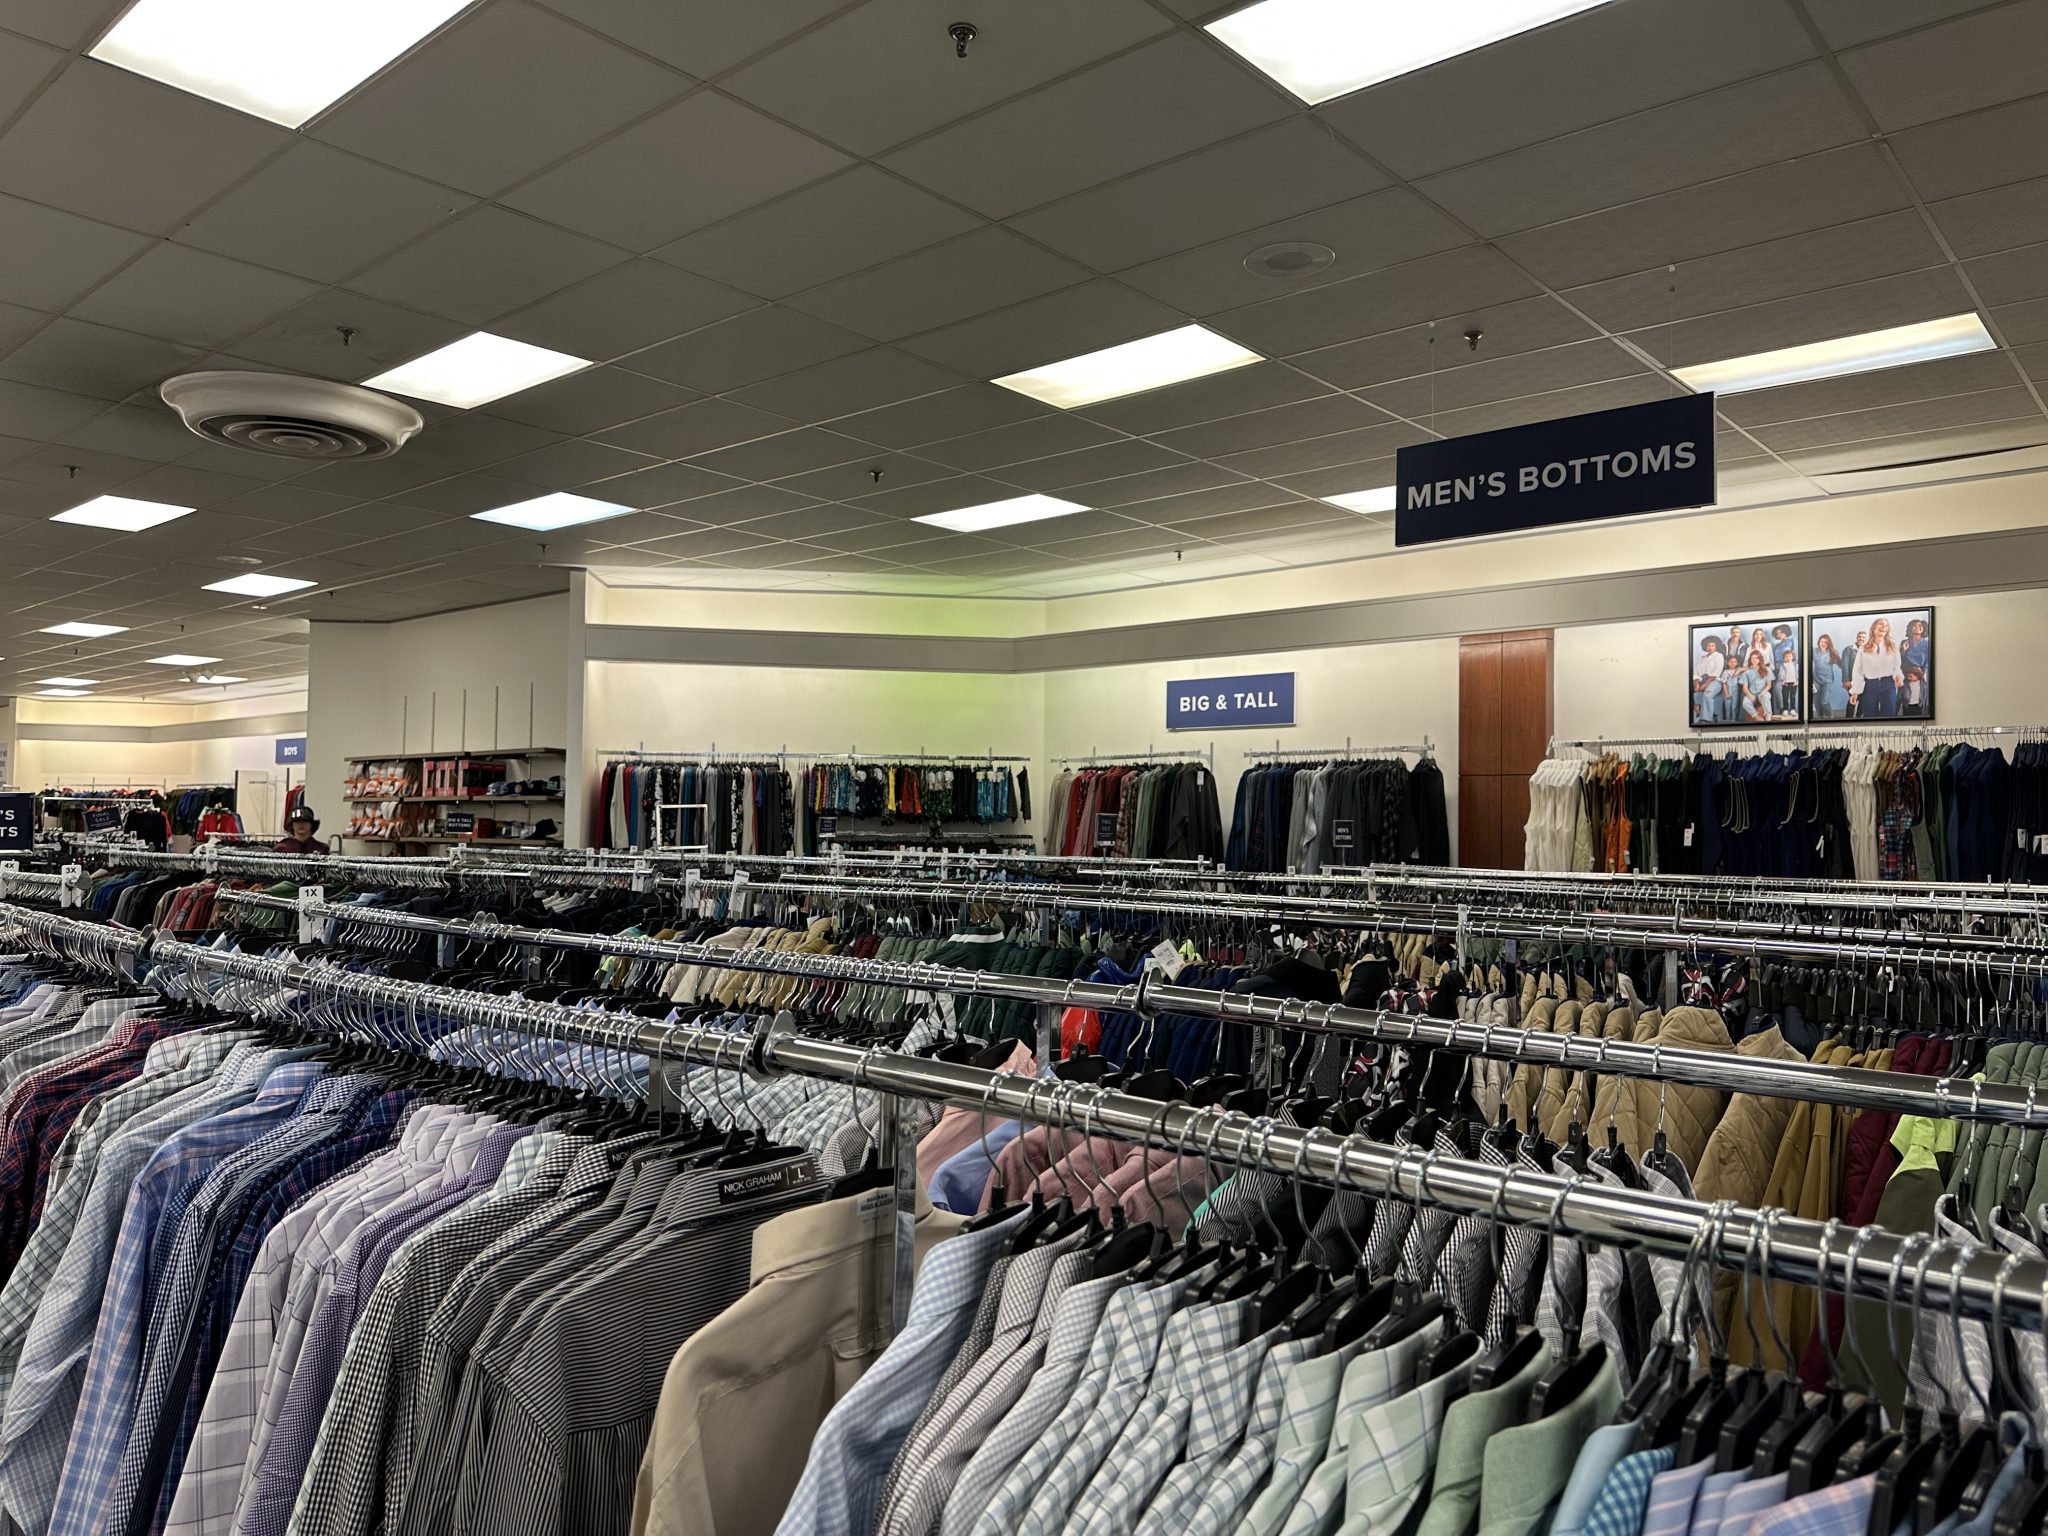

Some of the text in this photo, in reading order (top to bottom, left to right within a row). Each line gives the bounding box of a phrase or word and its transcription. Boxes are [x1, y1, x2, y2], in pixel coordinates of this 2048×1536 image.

[1407, 441, 1697, 510] MEN'S BOTTOMS
[1180, 691, 1278, 712] BIG & TALL
[284, 746, 298, 756] BOYS
[304, 888, 317, 897] 1X
[611, 1150, 629, 1163] NICK
[797, 1167, 805, 1179] L
[723, 1180, 745, 1194] NICK
[745, 1171, 782, 1188] GRAHAM
[1394, 1295, 1403, 1306] M
